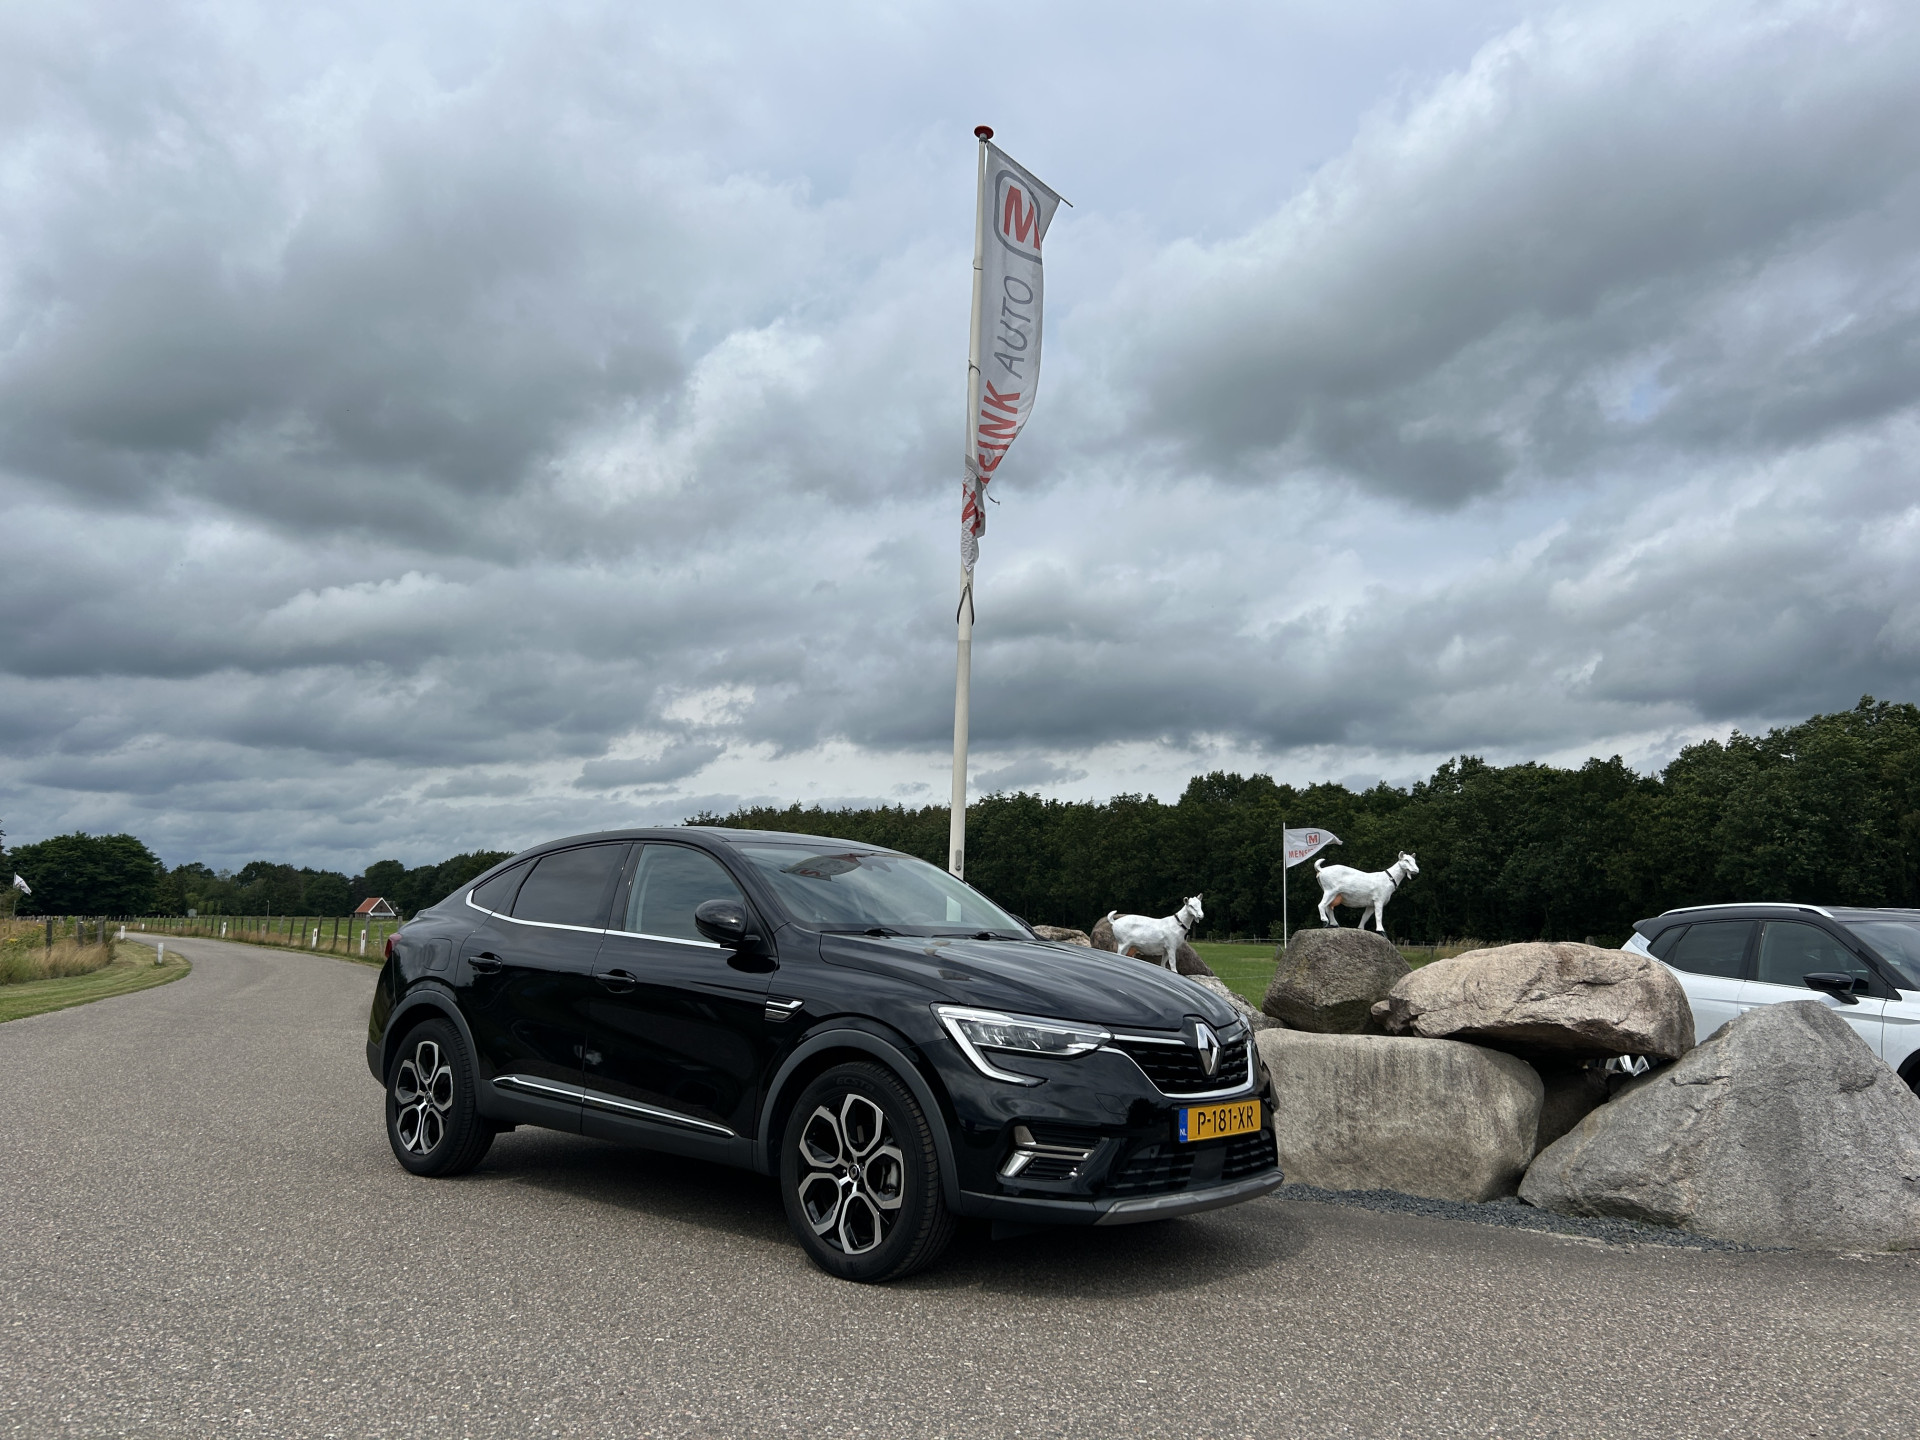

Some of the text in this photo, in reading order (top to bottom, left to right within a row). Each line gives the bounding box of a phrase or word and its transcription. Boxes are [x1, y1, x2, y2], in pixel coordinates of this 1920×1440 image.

[1003, 185, 1041, 251] M
[993, 275, 1034, 380] AUTO
[1308, 834, 1318, 844] M
[1179, 1105, 1254, 1136] NL P-181-XR
